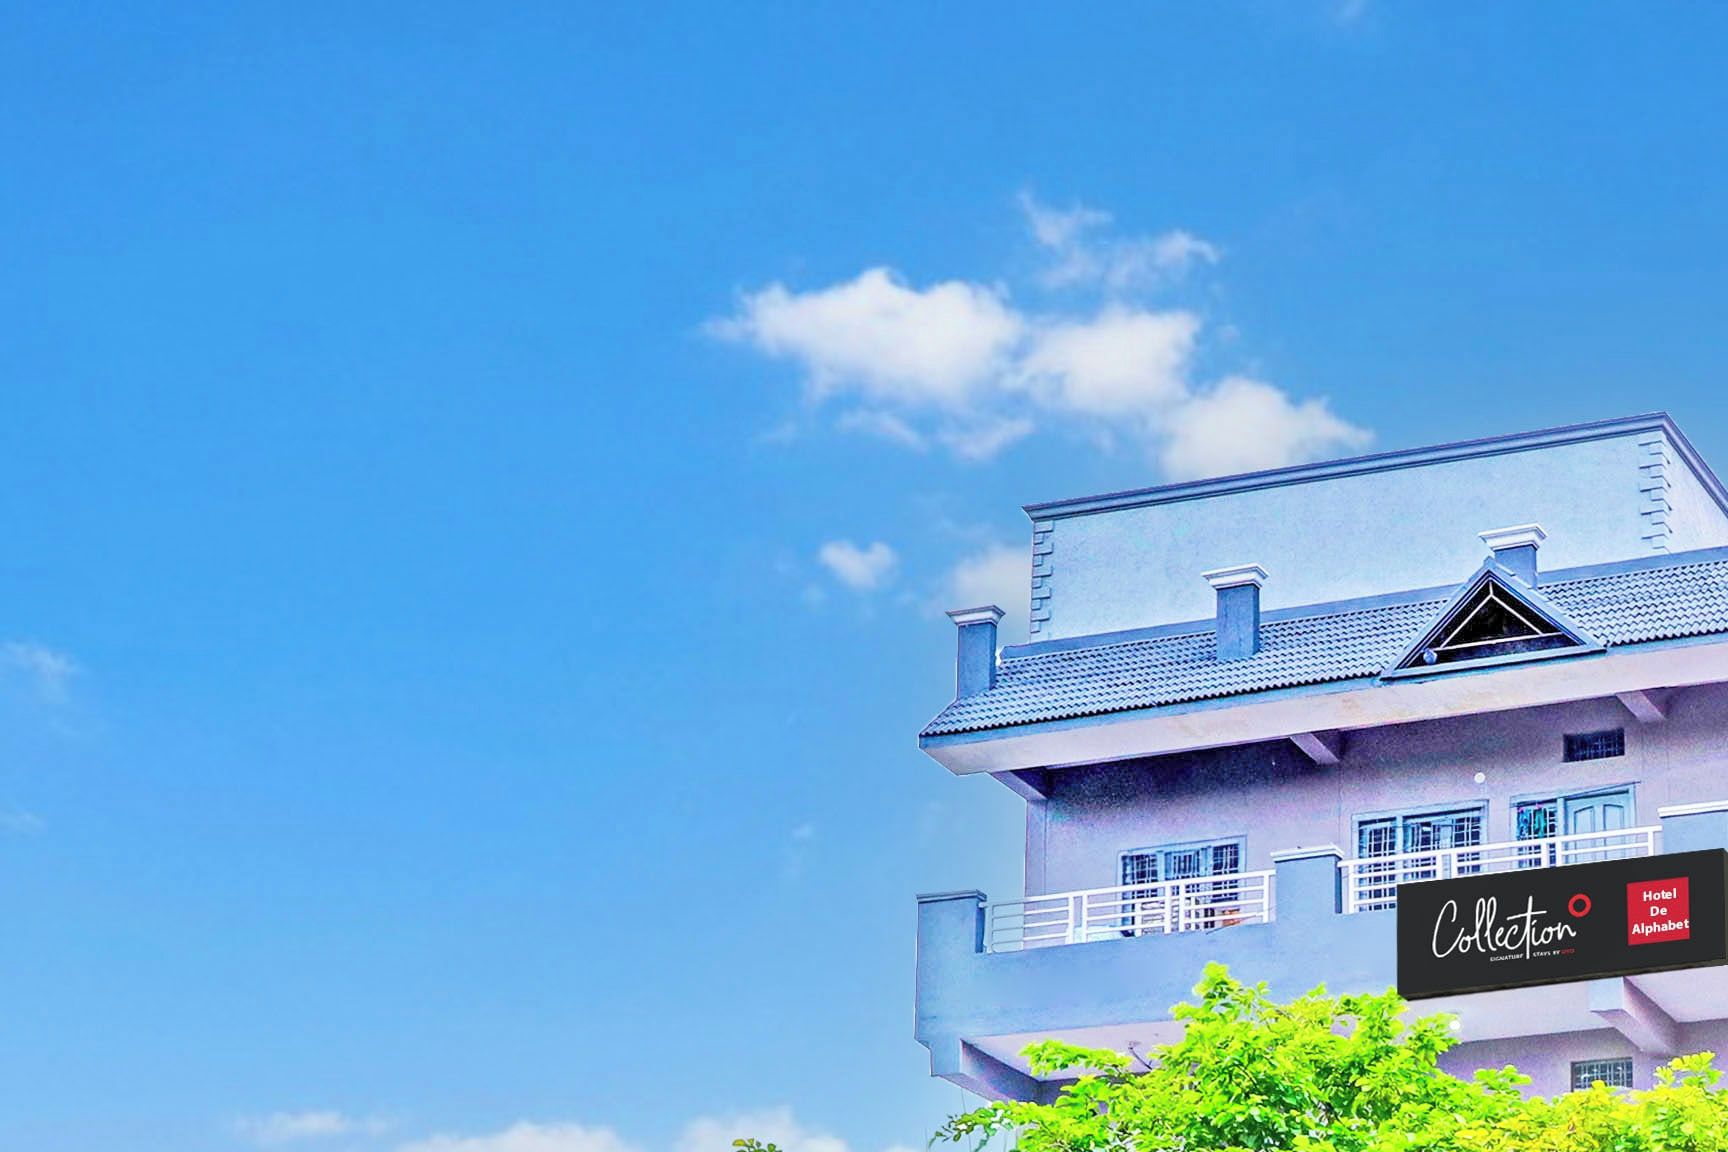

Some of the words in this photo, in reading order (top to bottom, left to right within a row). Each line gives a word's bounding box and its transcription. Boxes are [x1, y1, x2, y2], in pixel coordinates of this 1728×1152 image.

[1643, 888, 1677, 902] Hotel
[1650, 906, 1668, 917] De
[1432, 896, 1577, 959] Collection
[1631, 918, 1690, 936] Alphabet
